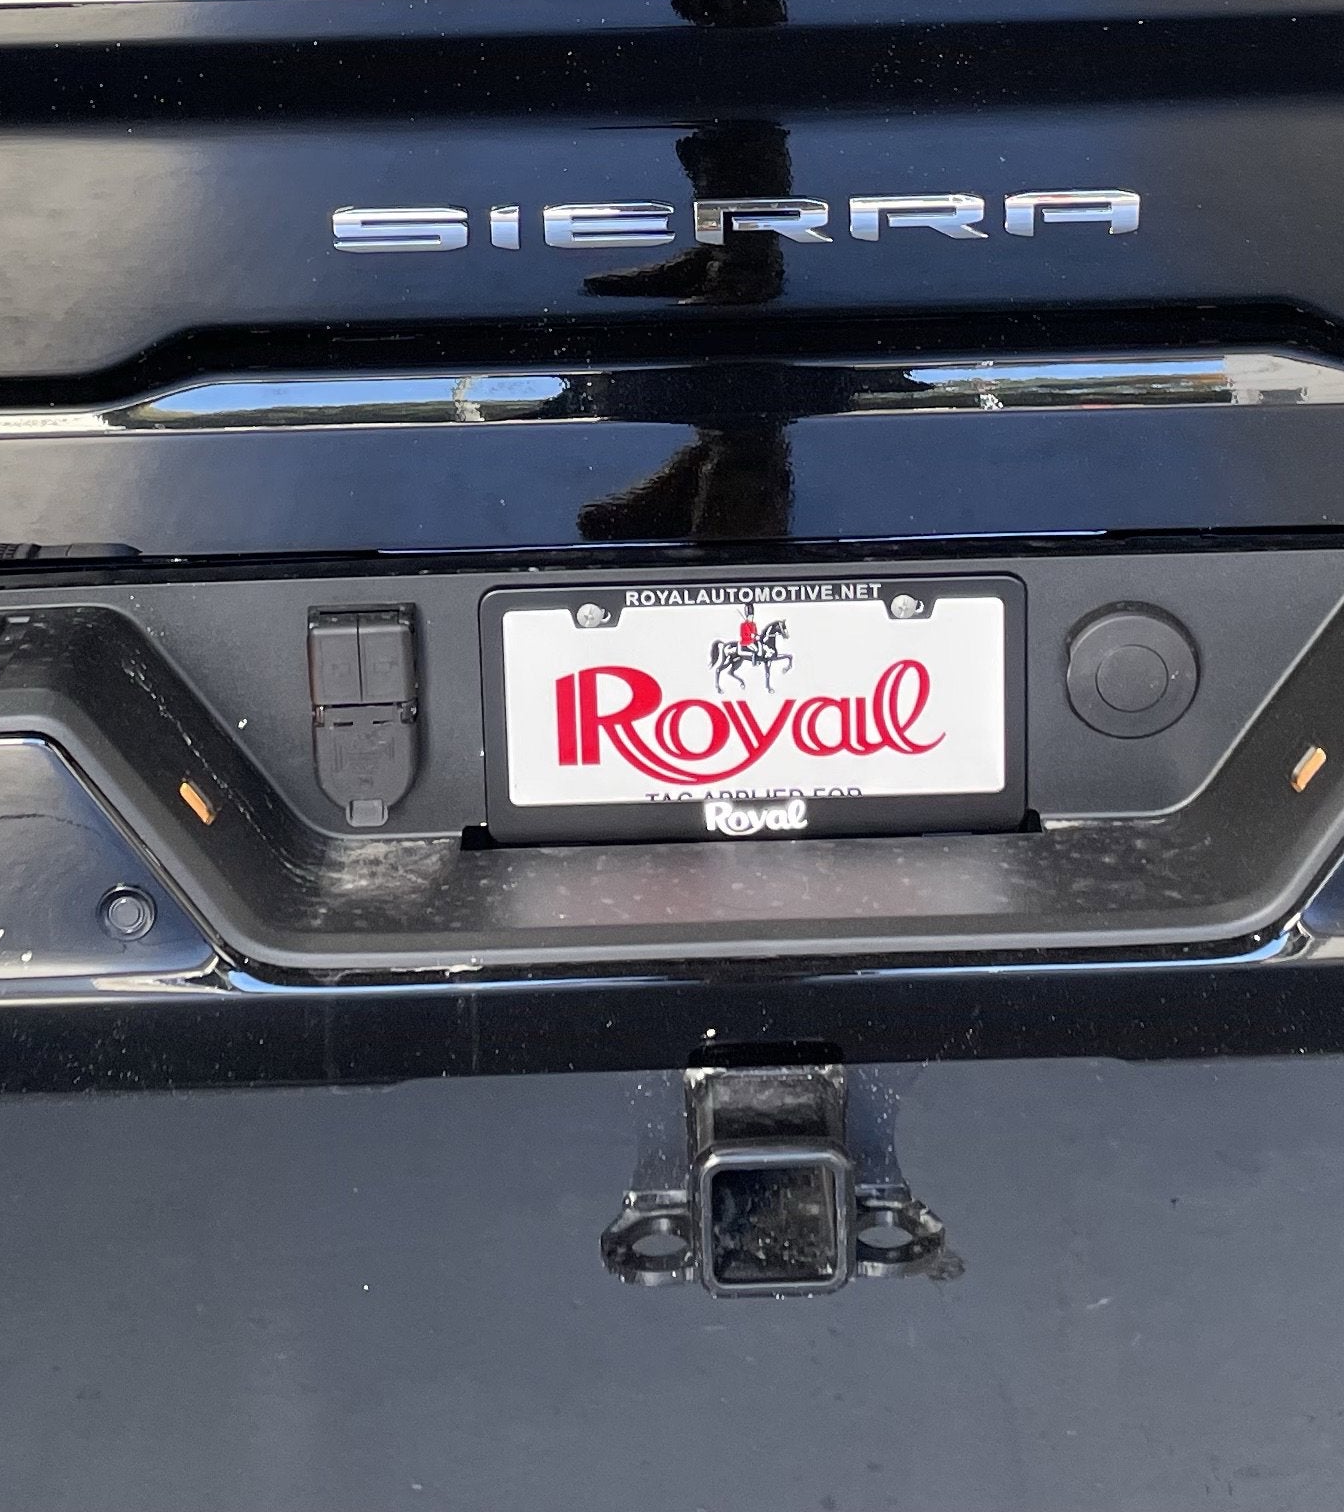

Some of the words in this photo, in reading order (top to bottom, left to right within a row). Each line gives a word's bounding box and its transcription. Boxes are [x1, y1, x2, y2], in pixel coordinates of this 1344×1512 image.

[331, 188, 1141, 252] SIERRA
[625, 583, 882, 606] ROYALAUTOMOTIVE.NET
[555, 659, 947, 785] Royal
[705, 799, 808, 836] Royal
